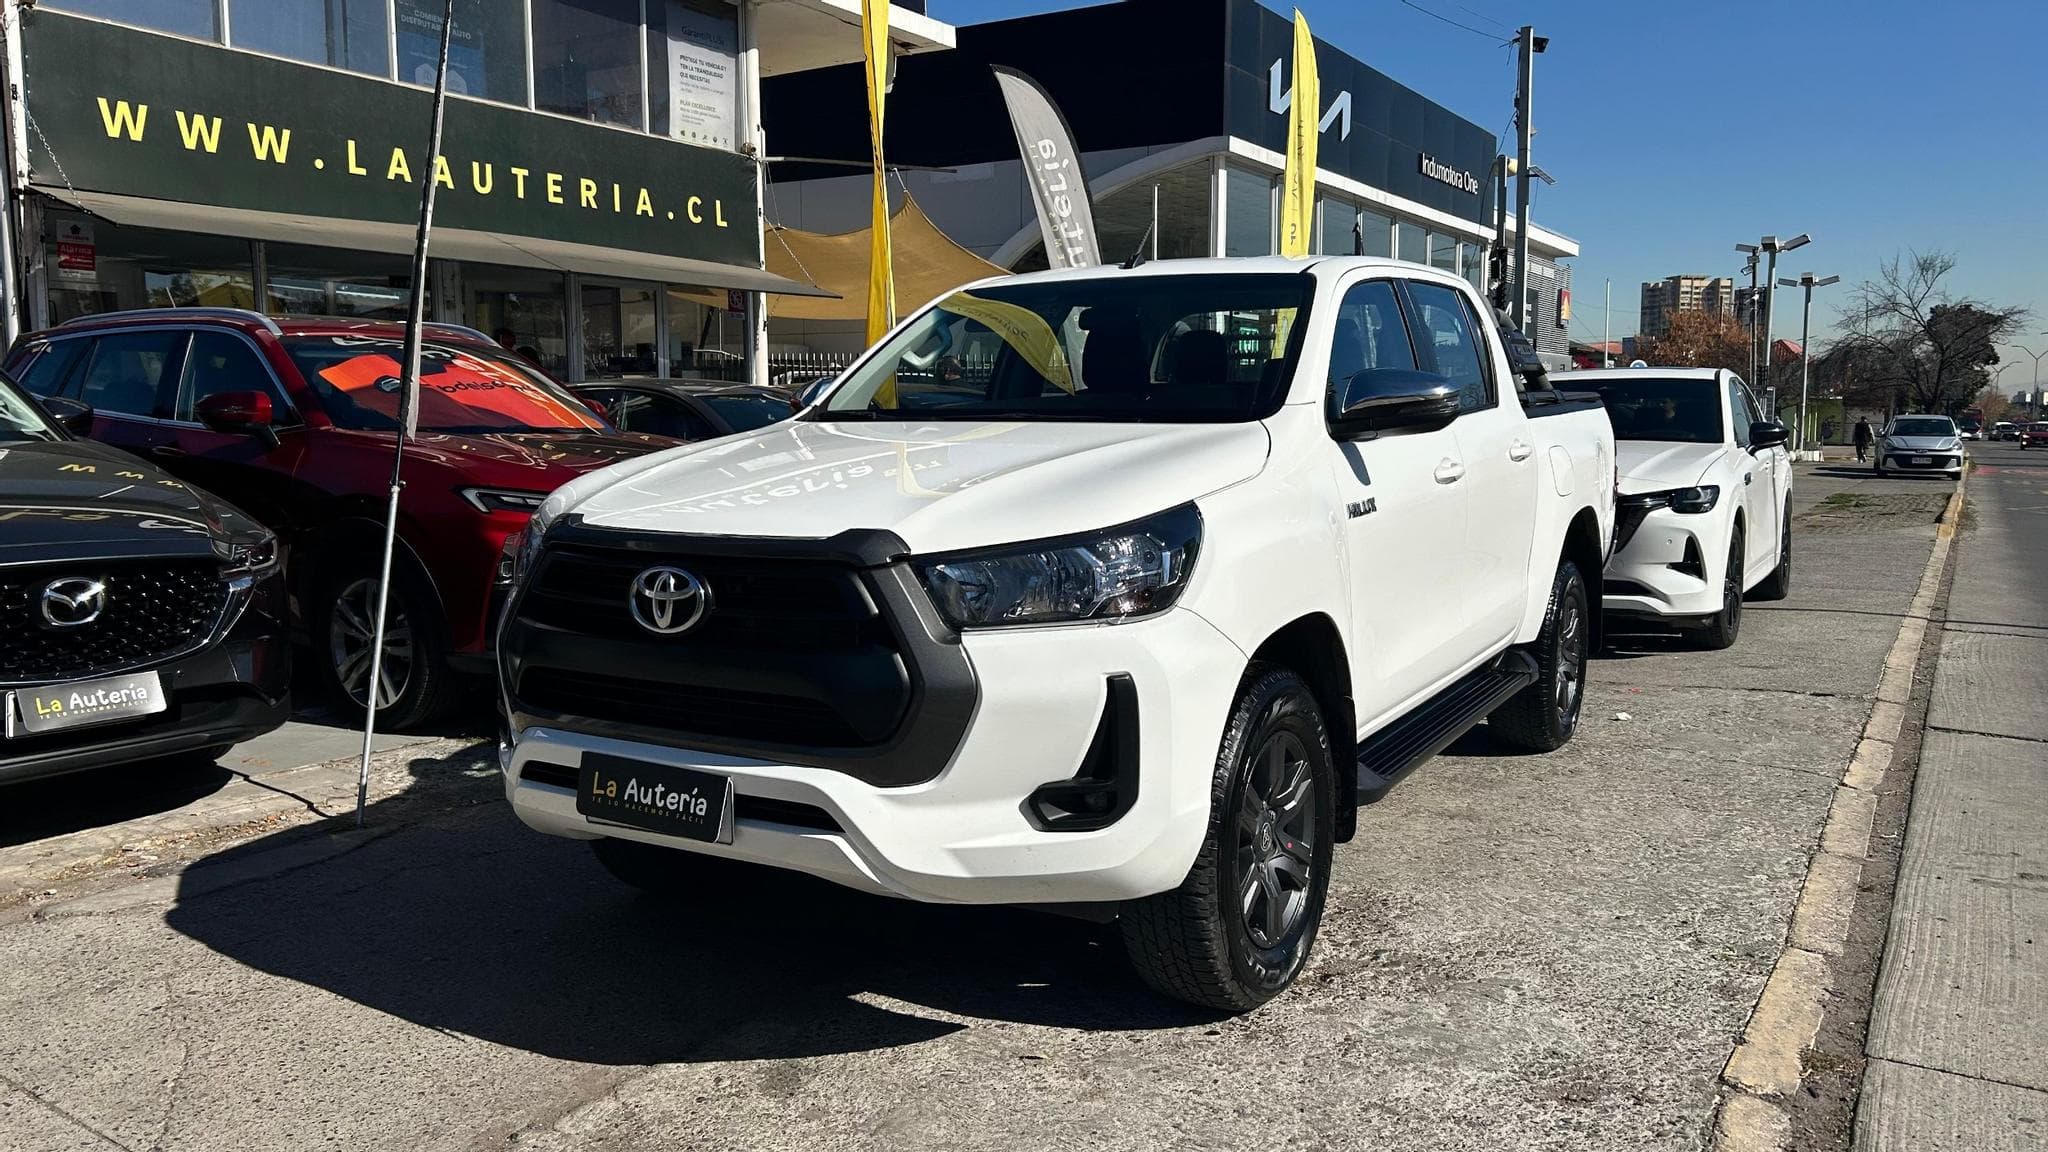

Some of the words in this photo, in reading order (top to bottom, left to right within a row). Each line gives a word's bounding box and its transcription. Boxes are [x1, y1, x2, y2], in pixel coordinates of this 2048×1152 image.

[1422, 152, 1463, 189] Indumotora
[1464, 170, 1479, 195] One
[36, 697, 62, 715] La
[69, 683, 148, 711] Autería
[592, 771, 617, 798] La
[624, 777, 708, 816] Autería
[625, 803, 670, 817] HACEMOS
